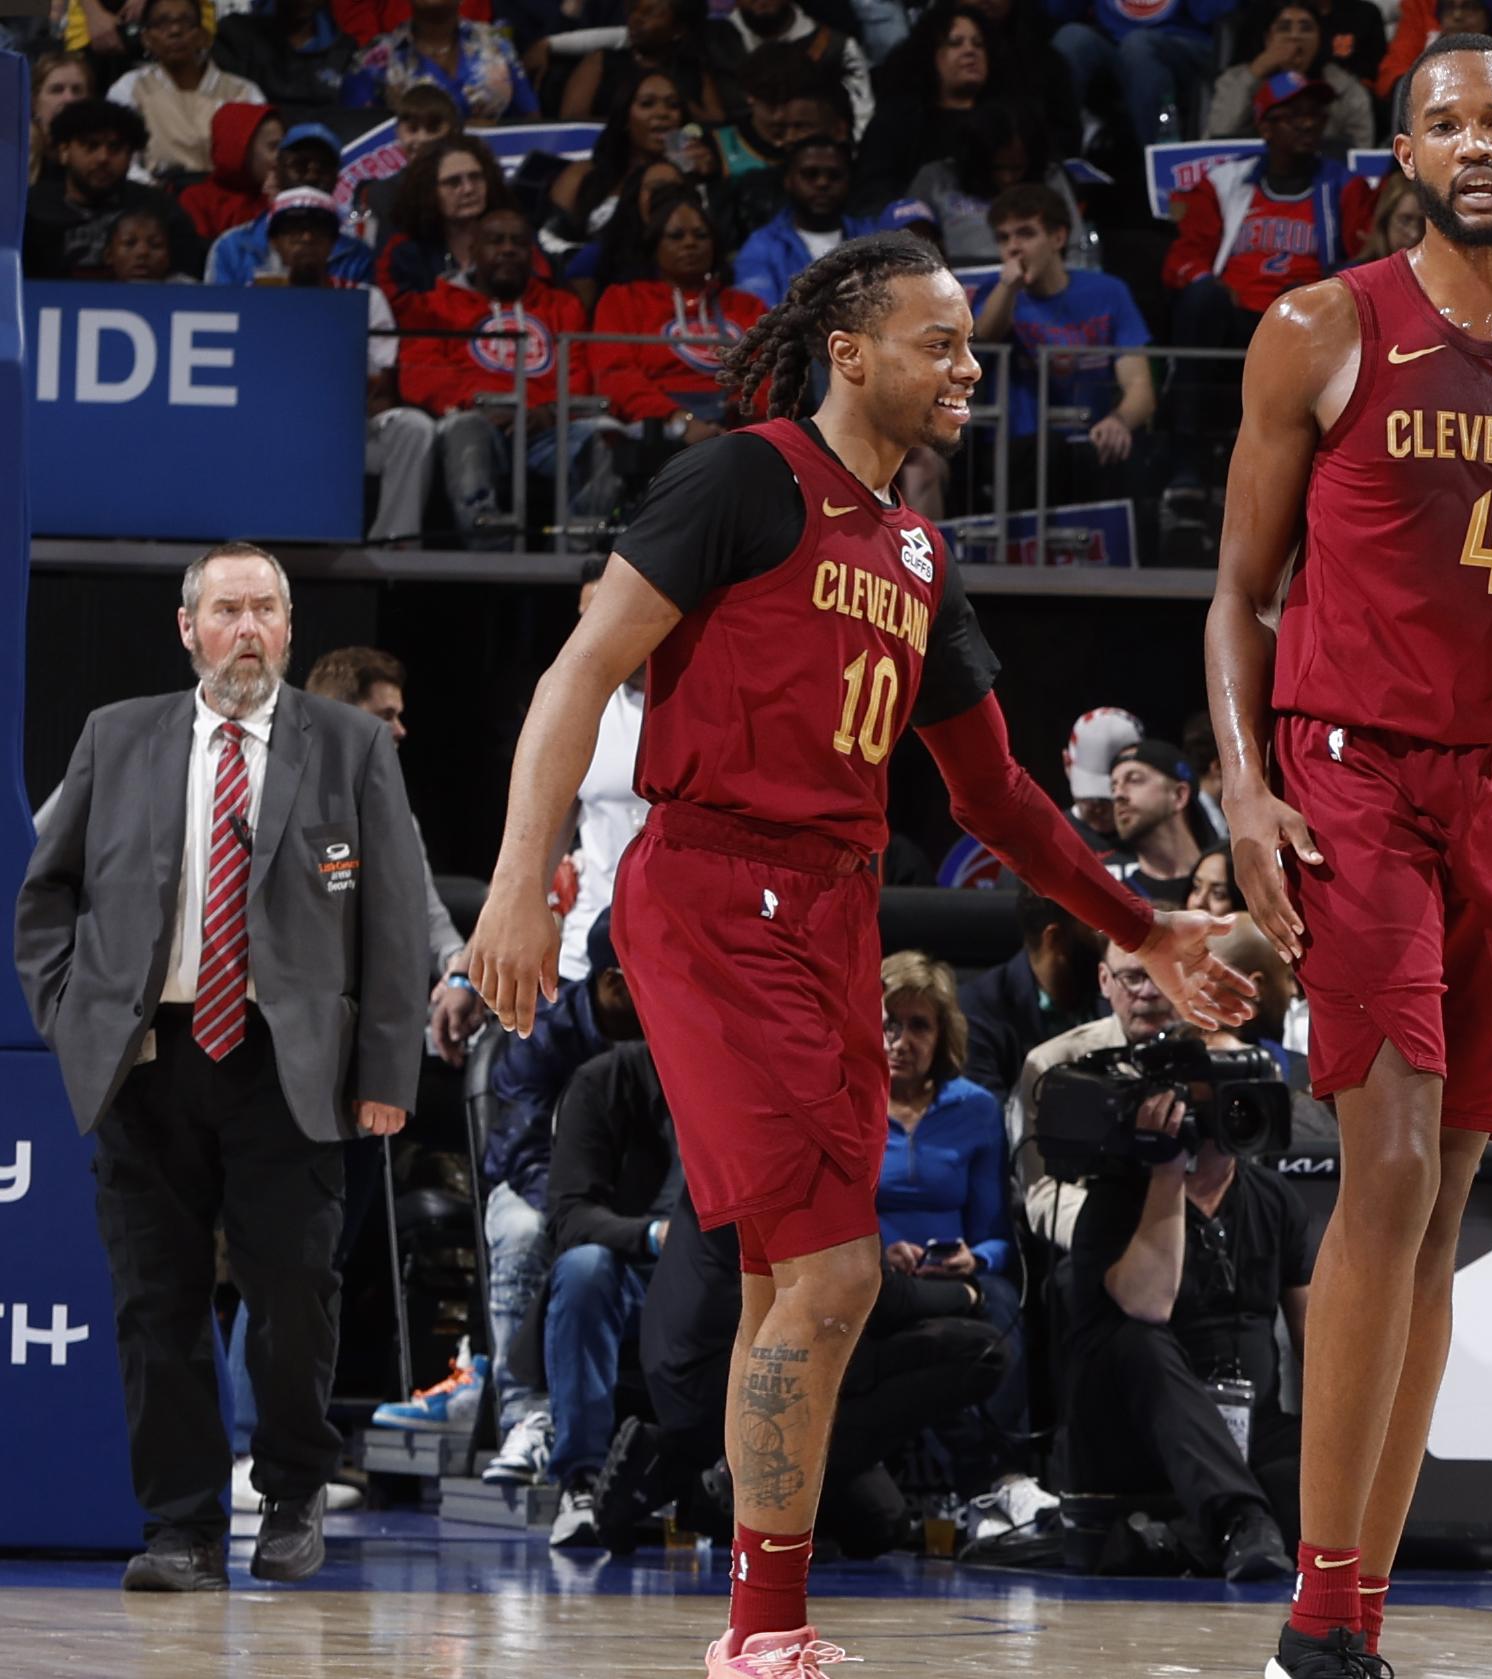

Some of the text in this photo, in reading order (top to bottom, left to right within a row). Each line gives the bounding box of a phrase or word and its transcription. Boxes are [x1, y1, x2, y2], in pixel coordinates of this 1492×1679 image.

[36, 308, 239, 405] IDE
[903, 550, 932, 579] CLIFFS
[812, 560, 929, 656] CLEVELAND
[832, 649, 899, 765] 10
[1278, 1157, 1334, 1173] KIA
[0, 1303, 89, 1366] H
[749, 1373, 801, 1394] GARY
